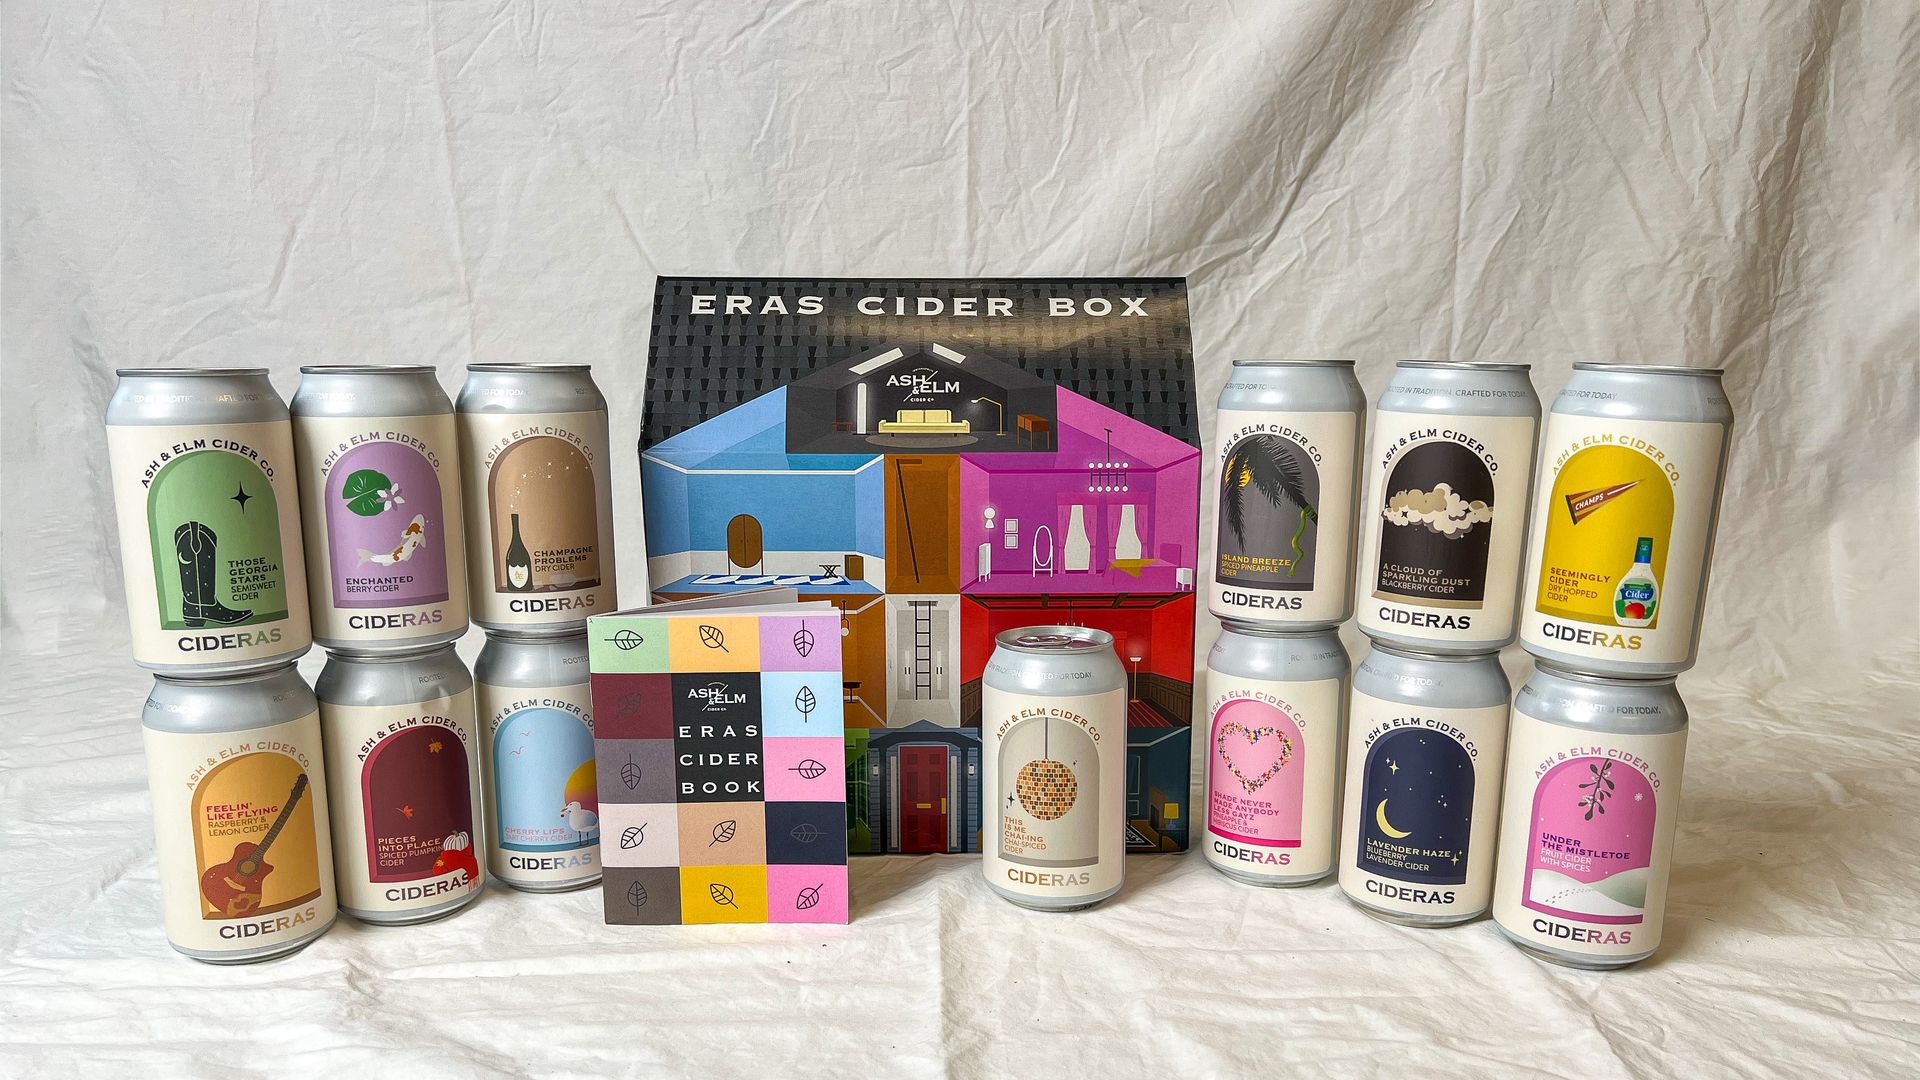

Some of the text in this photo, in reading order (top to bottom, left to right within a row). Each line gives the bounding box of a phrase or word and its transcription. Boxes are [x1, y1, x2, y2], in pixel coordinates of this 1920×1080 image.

[690, 294, 1149, 317] ERAS CIDER BOX
[886, 375, 960, 393] ASH ELM
[1455, 389, 1507, 398] CRAFTED FOR
[1577, 390, 1590, 398] FOR
[484, 445, 501, 469] ASH
[501, 437, 511, 446] &
[511, 426, 540, 441] ELM
[544, 426, 582, 447] CIDER
[1220, 440, 1232, 463] ASH
[1233, 433, 1240, 441] &
[1241, 424, 1265, 436] ELM
[1270, 424, 1308, 447] CIDER
[321, 451, 338, 476] ASH
[339, 443, 349, 452] &
[350, 432, 380, 446] ELM
[386, 432, 426, 452] CIDER
[1382, 428, 1498, 476] ASH & ELM CIDER CO.
[1553, 450, 1570, 475] ASH
[1572, 442, 1580, 452] &
[1583, 434, 1612, 446] ELM
[1619, 436, 1664, 462] CIDER
[141, 461, 160, 488] ASH
[160, 452, 170, 462] &
[173, 439, 206, 454] ELM
[212, 439, 258, 461] CIDER
[1575, 493, 1604, 511] CHAMPS
[533, 545, 593, 558] CHAMPAGNE
[228, 557, 266, 568] THOSE
[534, 555, 587, 565] PROBLEMS
[1221, 553, 1290, 566] ISLAND BREEZE
[1221, 560, 1278, 573] SPICED PINEAPPLE
[229, 563, 278, 576] GEORGIA
[535, 563, 575, 573] DRY CIDER
[1221, 568, 1237, 576] CIDER
[1390, 564, 1424, 575] CLOUD
[1550, 567, 1611, 583] SEEMINGLY
[230, 574, 266, 585] STARS
[346, 576, 414, 585] ENCHANTED
[1382, 570, 1471, 586] SPARKLING DUST
[1550, 576, 1578, 587] CIDER
[231, 580, 276, 593] SEMISWEET
[374, 584, 400, 592] CIDER
[1382, 578, 1455, 594] BLACKBERRY CIDER
[1548, 584, 1598, 598] DRY HOPPED
[232, 592, 259, 601] CIDER
[1222, 590, 1303, 610] CIDERAS
[1548, 592, 1568, 602] CIDER
[1625, 590, 1650, 599] Cider
[509, 594, 595, 613] CIDERAS
[349, 610, 443, 630] CIDERAS
[1379, 606, 1471, 630] CIDERAS
[178, 628, 282, 652] CIDERAS
[1543, 622, 1642, 650] CIDERAS
[687, 688, 746, 704] ASH ELM
[1210, 690, 1293, 718] ASH ELM CIDER
[1616, 706, 1662, 715] FOR TODAY.
[490, 698, 581, 734] ASH ELM CIDER
[679, 725, 758, 738] ERAS
[996, 721, 1011, 741] ASH
[1021, 708, 1046, 718] ELM
[1051, 708, 1088, 727] CIDER
[357, 738, 376, 762] ASH
[376, 731, 387, 739] &
[388, 717, 417, 733] ELM
[422, 716, 457, 730] CIDER
[1364, 718, 1478, 762] ASH & ELM CIDER CO.
[186, 741, 297, 791] ASH ELM CIDER
[679, 753, 759, 766] CIDER
[1534, 756, 1554, 779] ASH
[1558, 752, 1567, 761] &
[1570, 746, 1602, 756] ELM
[1608, 748, 1648, 772] CIDER
[682, 780, 760, 794] BOOK
[1214, 790, 1272, 809] SHADE NEVER
[1214, 798, 1280, 816] MADE ANYBODY
[206, 803, 252, 812] FEELIN'
[207, 806, 279, 821] LIKE FLYING
[1214, 805, 1255, 820] LESS GAYZ
[208, 817, 258, 829] RASPBERRY
[1004, 816, 1023, 826] THIS
[209, 824, 270, 837] LEMON CIDER
[505, 827, 540, 835] CHERRY
[1004, 831, 1044, 843] CHAI-ING
[1014, 826, 1026, 834] ME
[1238, 826, 1259, 835] CIDER
[378, 836, 416, 844] PIECES
[379, 838, 441, 852] INTO PLACE
[1004, 838, 1047, 850] CHAI-SPICED
[1542, 832, 1581, 847] UNDER
[379, 845, 444, 859] SPICED PUMPKIN
[1004, 845, 1024, 854] CIDER
[1214, 840, 1291, 866] CIDERAS
[1366, 845, 1407, 861] BLUEBERRY
[1368, 838, 1451, 858] LAVENDER HAZE
[1542, 840, 1630, 860] THE MISTLETOE
[509, 853, 592, 870] CIDERAS
[1366, 852, 1430, 872] LAVENDER CIDER
[1540, 856, 1591, 872] WITH SPICES
[1541, 850, 1592, 864] FRUIT CIDER
[1007, 868, 1090, 886] CIDERAS
[385, 872, 470, 902] CIDERAS
[1366, 880, 1455, 904] CIDERAS
[219, 906, 316, 940] CIDERAS
[1533, 919, 1632, 944] CIDERAS
